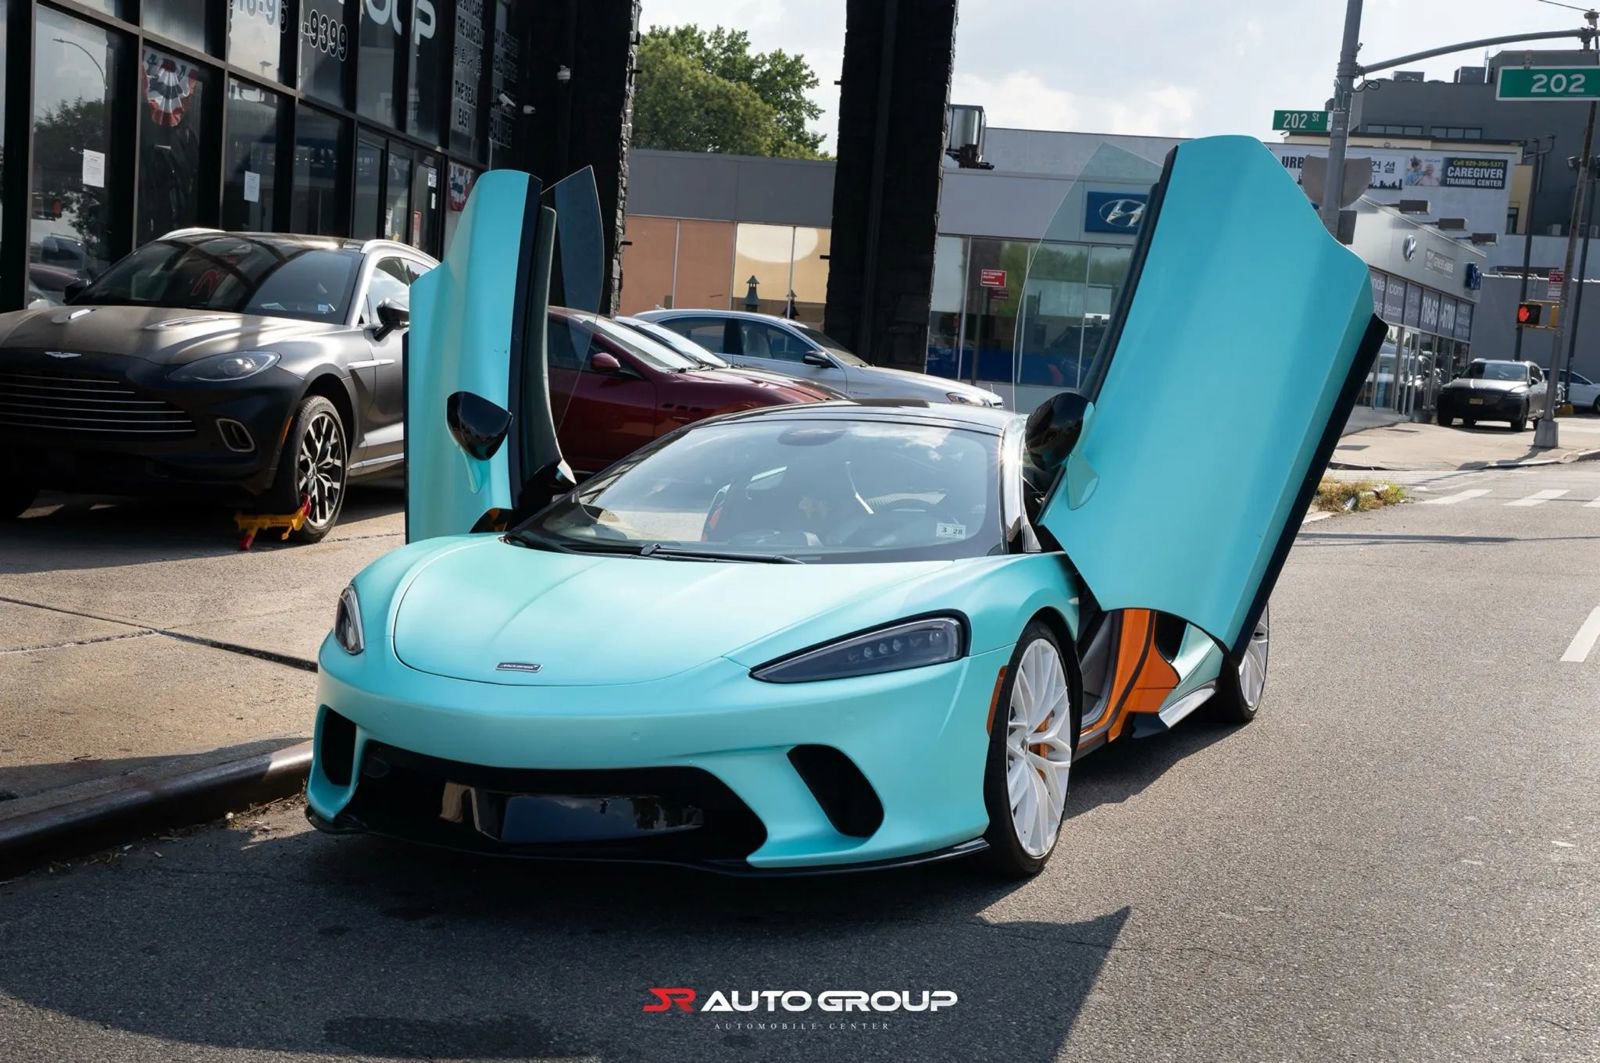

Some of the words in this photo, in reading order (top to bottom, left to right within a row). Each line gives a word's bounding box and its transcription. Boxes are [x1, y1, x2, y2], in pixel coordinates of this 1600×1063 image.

[1530, 73, 1586, 94] 202
[1283, 112, 1307, 129] 202
[1312, 112, 1320, 123] St
[1447, 166, 1504, 179] CAREGIVER
[1446, 177, 1476, 186] TRAINING
[1477, 178, 1503, 187] CENTER
